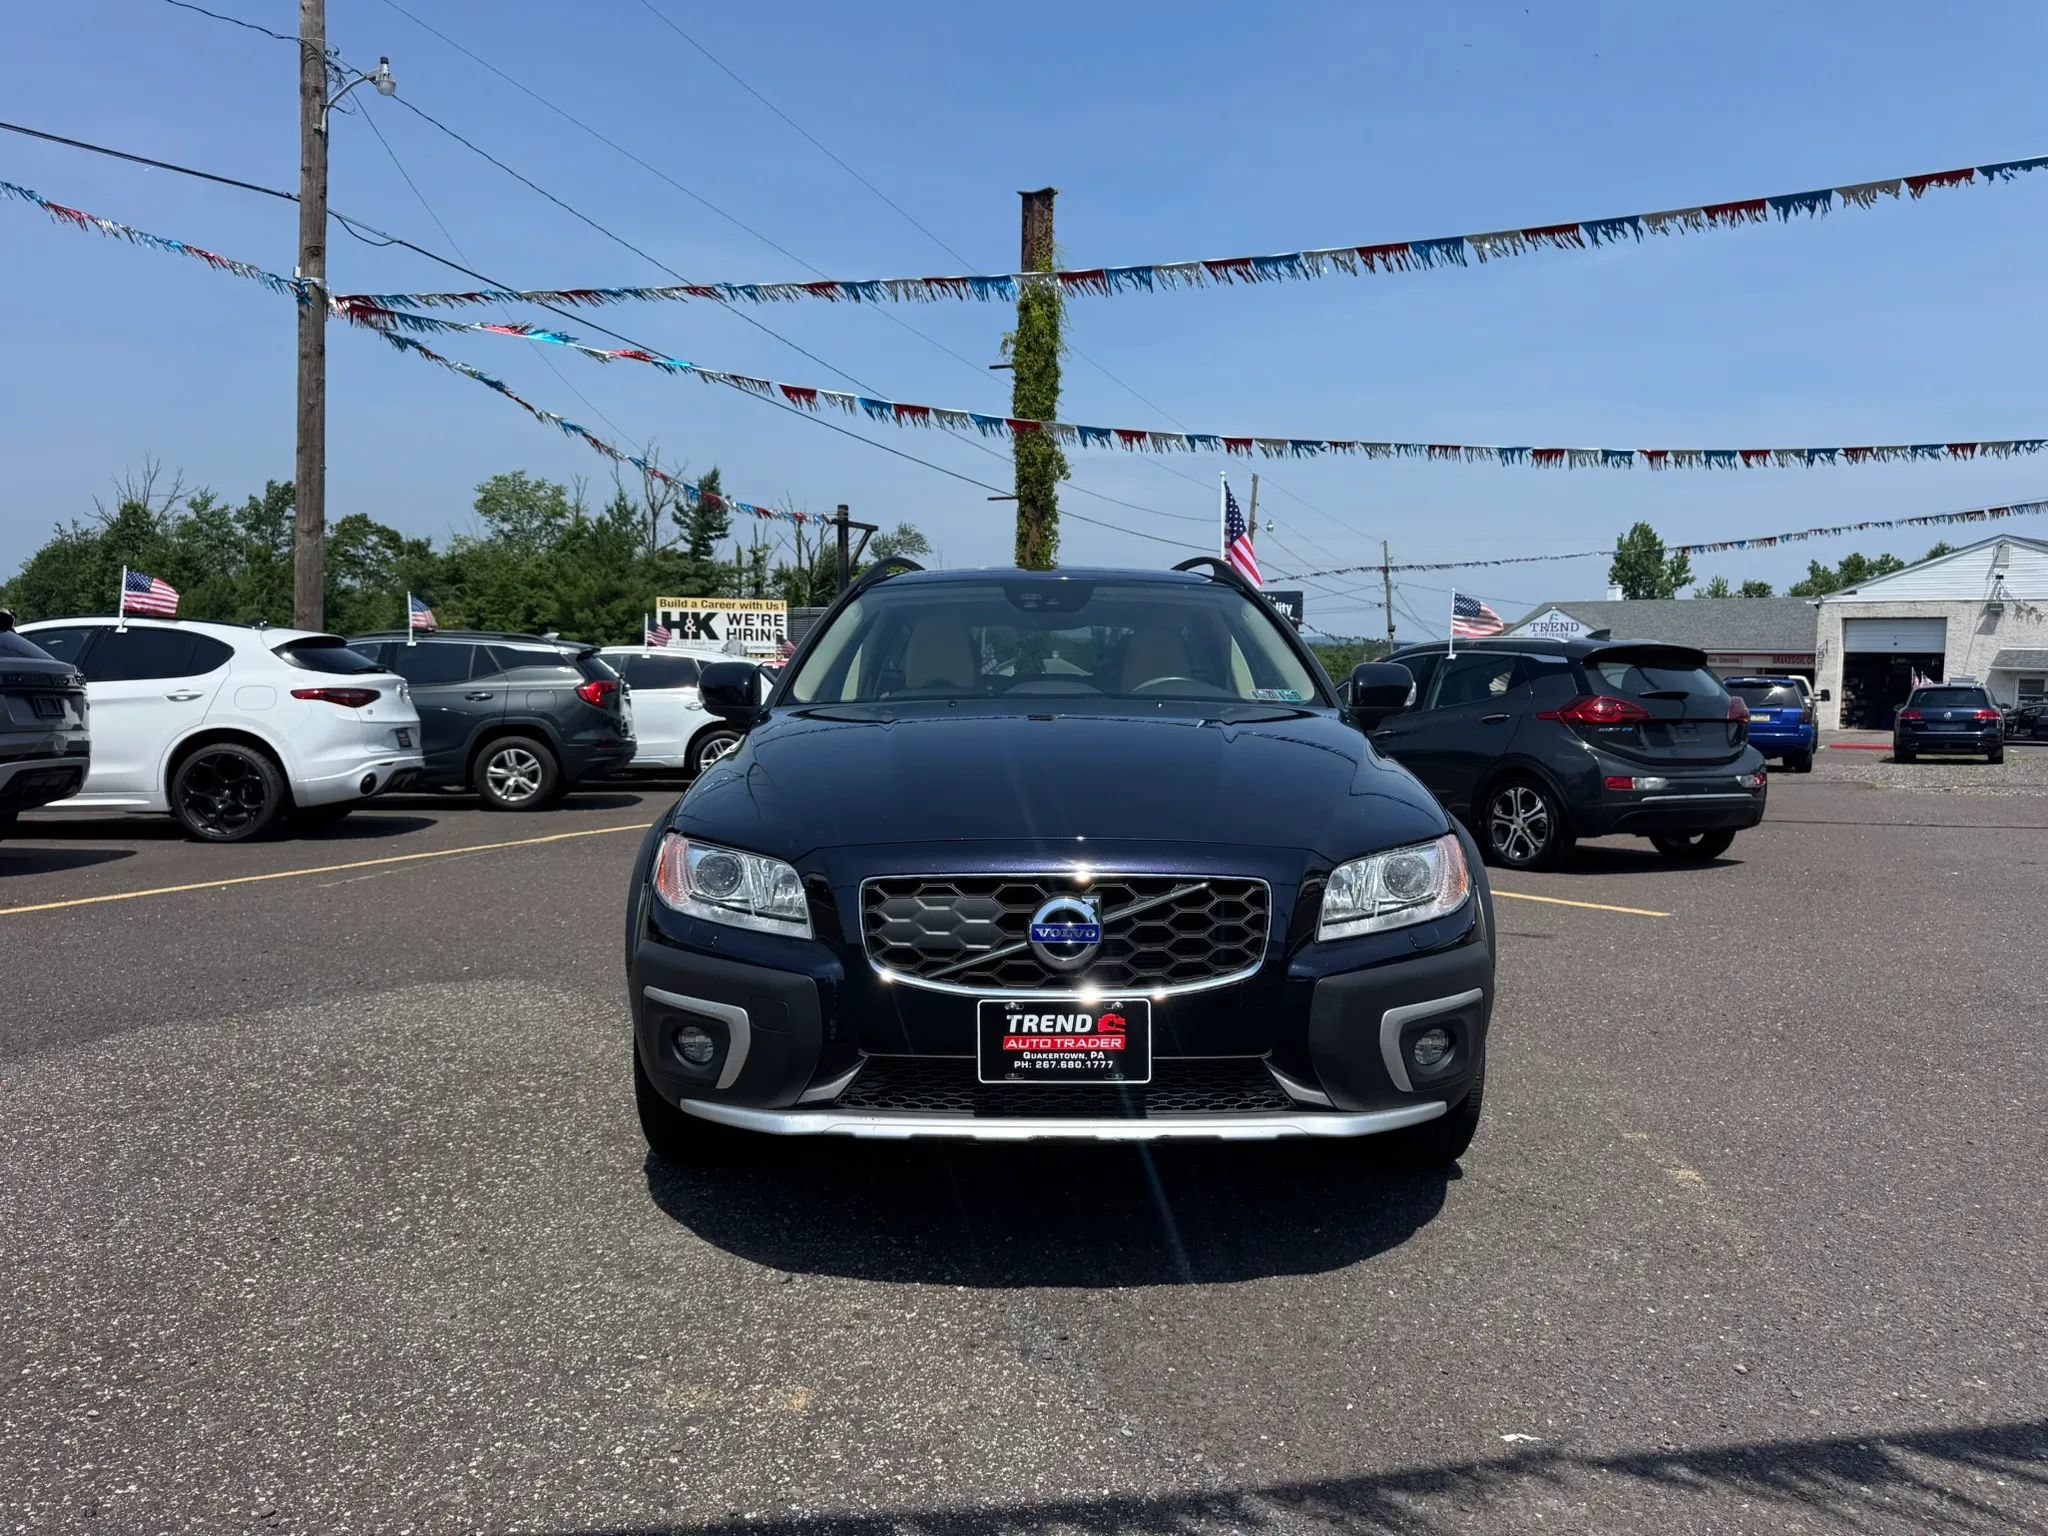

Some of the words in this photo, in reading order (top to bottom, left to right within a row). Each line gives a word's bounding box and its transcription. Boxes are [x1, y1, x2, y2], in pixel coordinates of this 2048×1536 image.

[659, 598, 688, 608] Build
[700, 600, 736, 609] Career
[739, 601, 763, 610] with
[661, 611, 720, 640] H&K
[726, 613, 784, 628] WE'RE
[1530, 622, 1580, 632] TREND
[1035, 927, 1096, 938] VOLVO
[1006, 1014, 1093, 1033] TREND
[1090, 1051, 1105, 1060] PA
[1014, 1060, 1032, 1069] PH:
[1035, 1060, 1114, 1069] 267.680.1777
